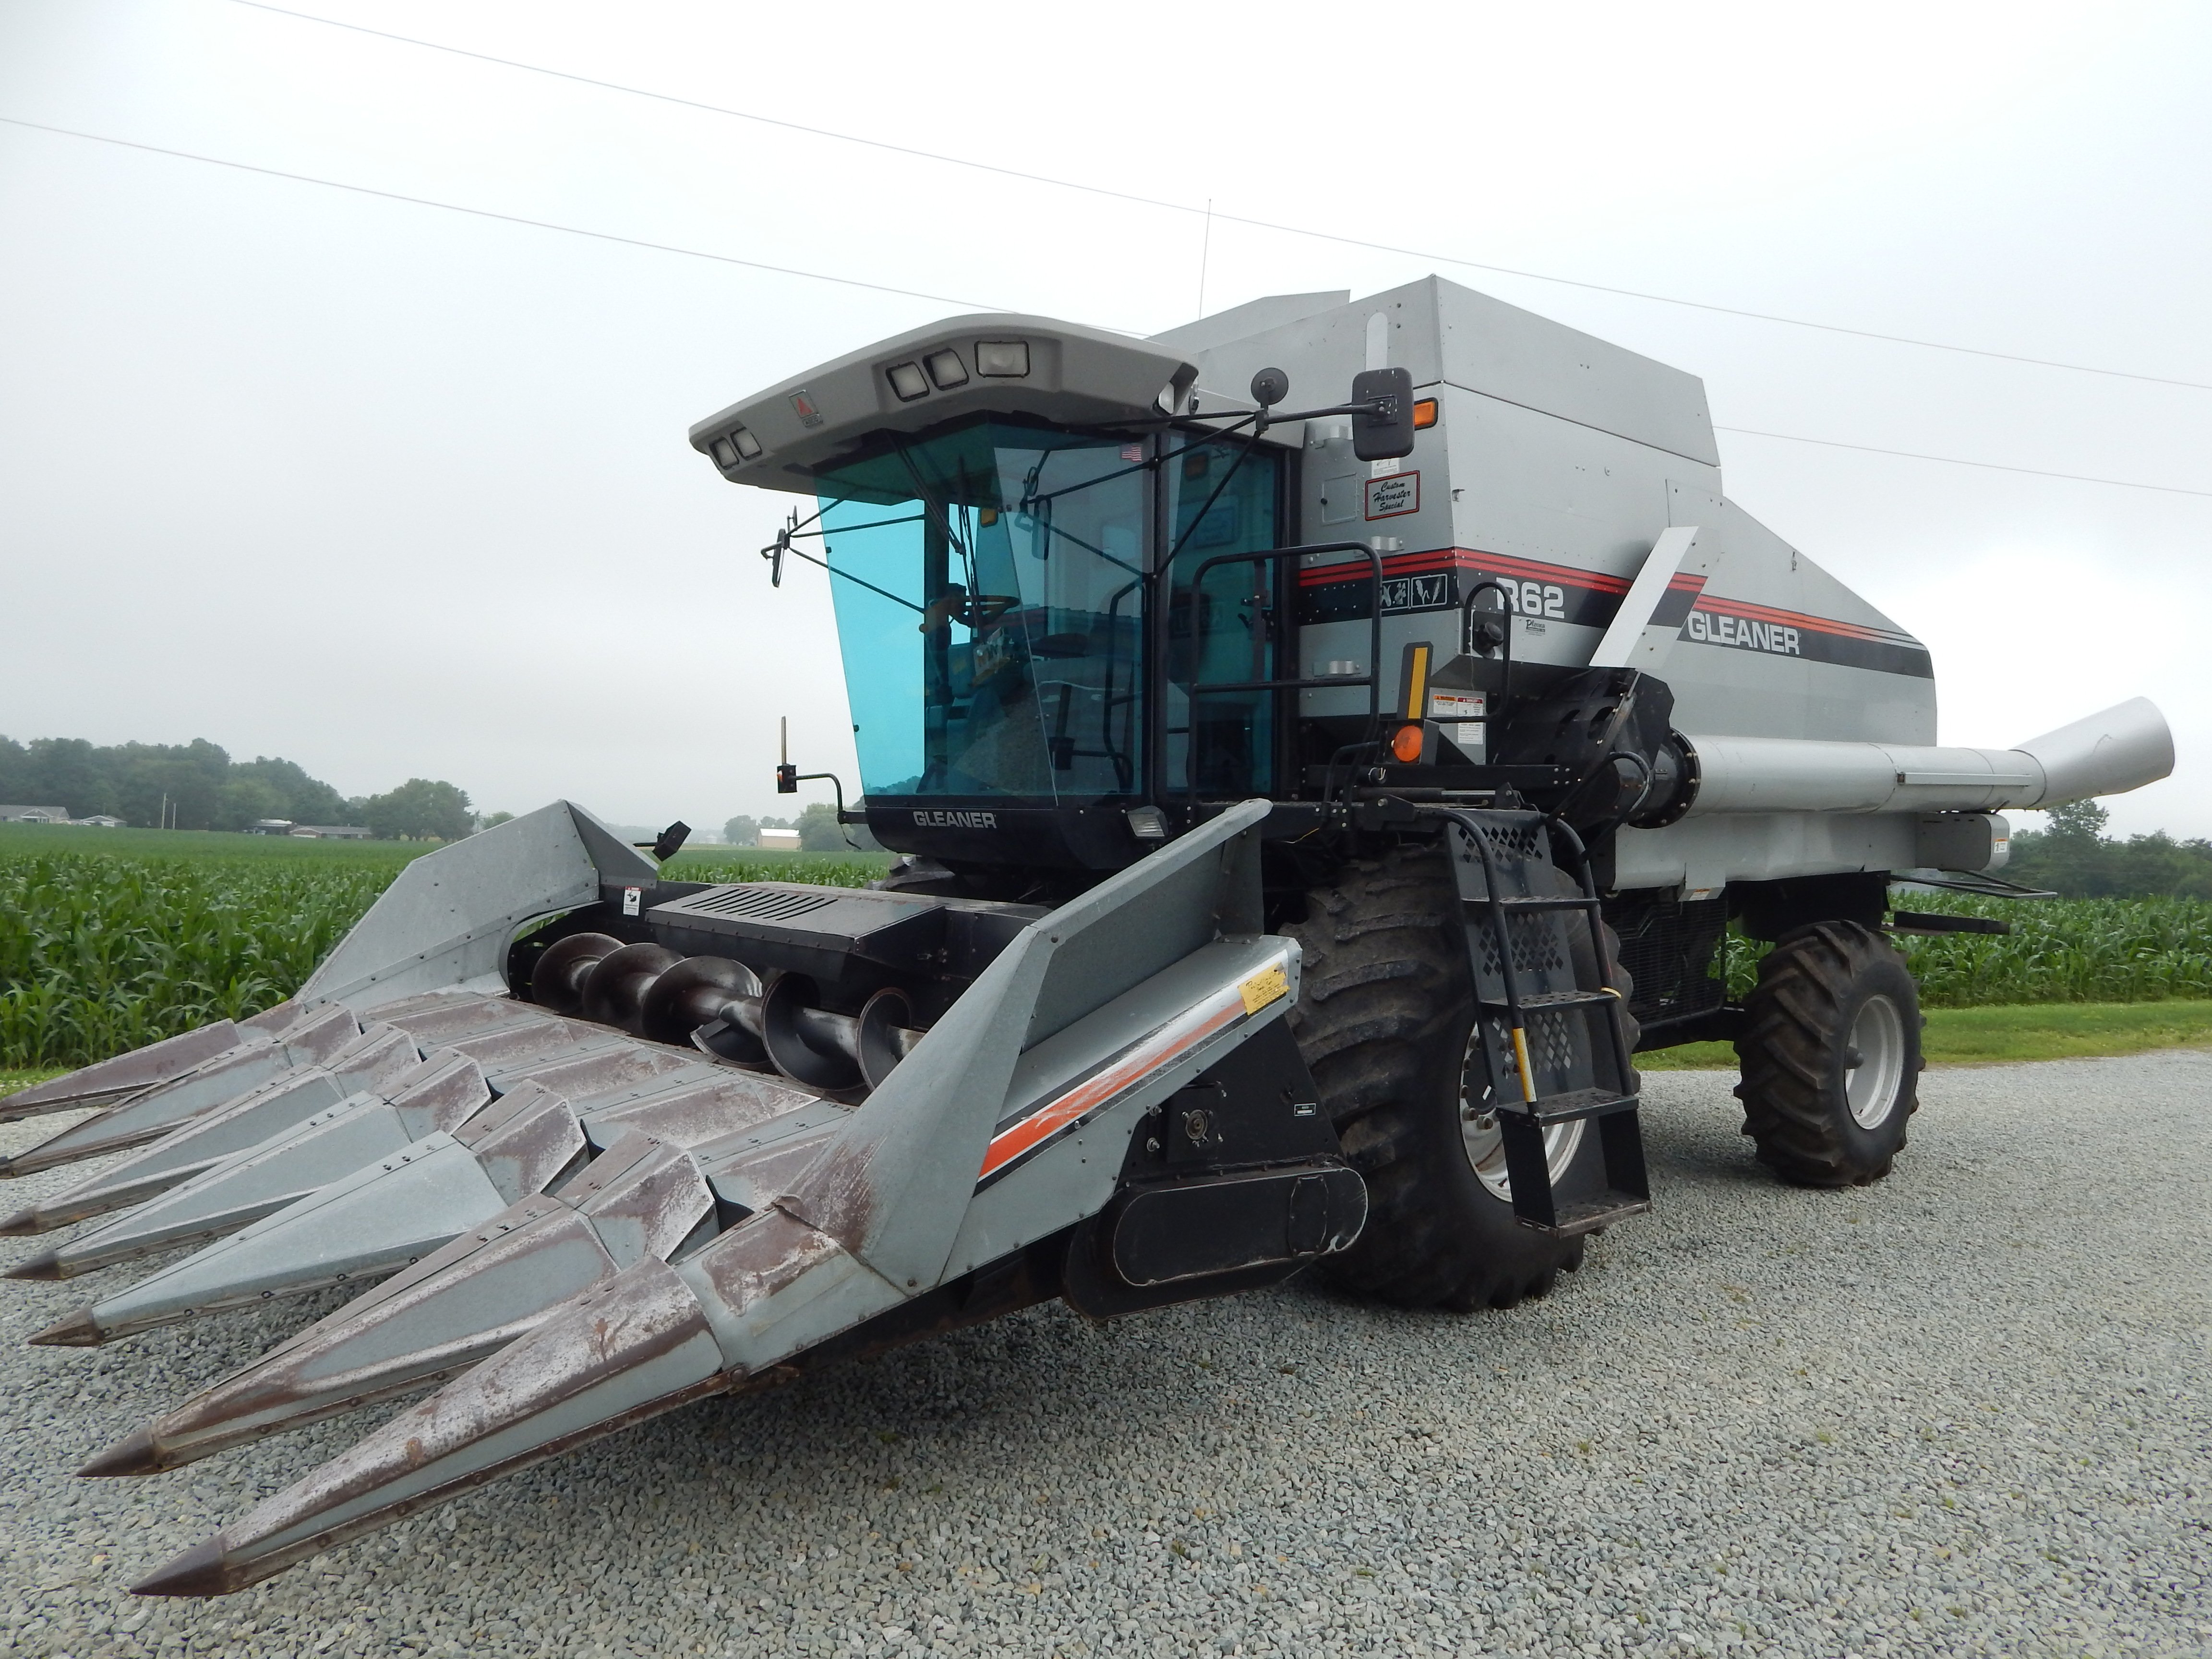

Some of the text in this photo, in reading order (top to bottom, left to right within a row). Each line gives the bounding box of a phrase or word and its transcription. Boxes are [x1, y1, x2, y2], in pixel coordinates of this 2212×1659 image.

[1381, 481, 1405, 492] Custom
[1373, 490, 1410, 503] Harvester
[1379, 499, 1404, 512] Special
[1496, 577, 1564, 619] R62
[1688, 611, 1800, 655] GLEANER
[913, 811, 997, 829] GLEANER
